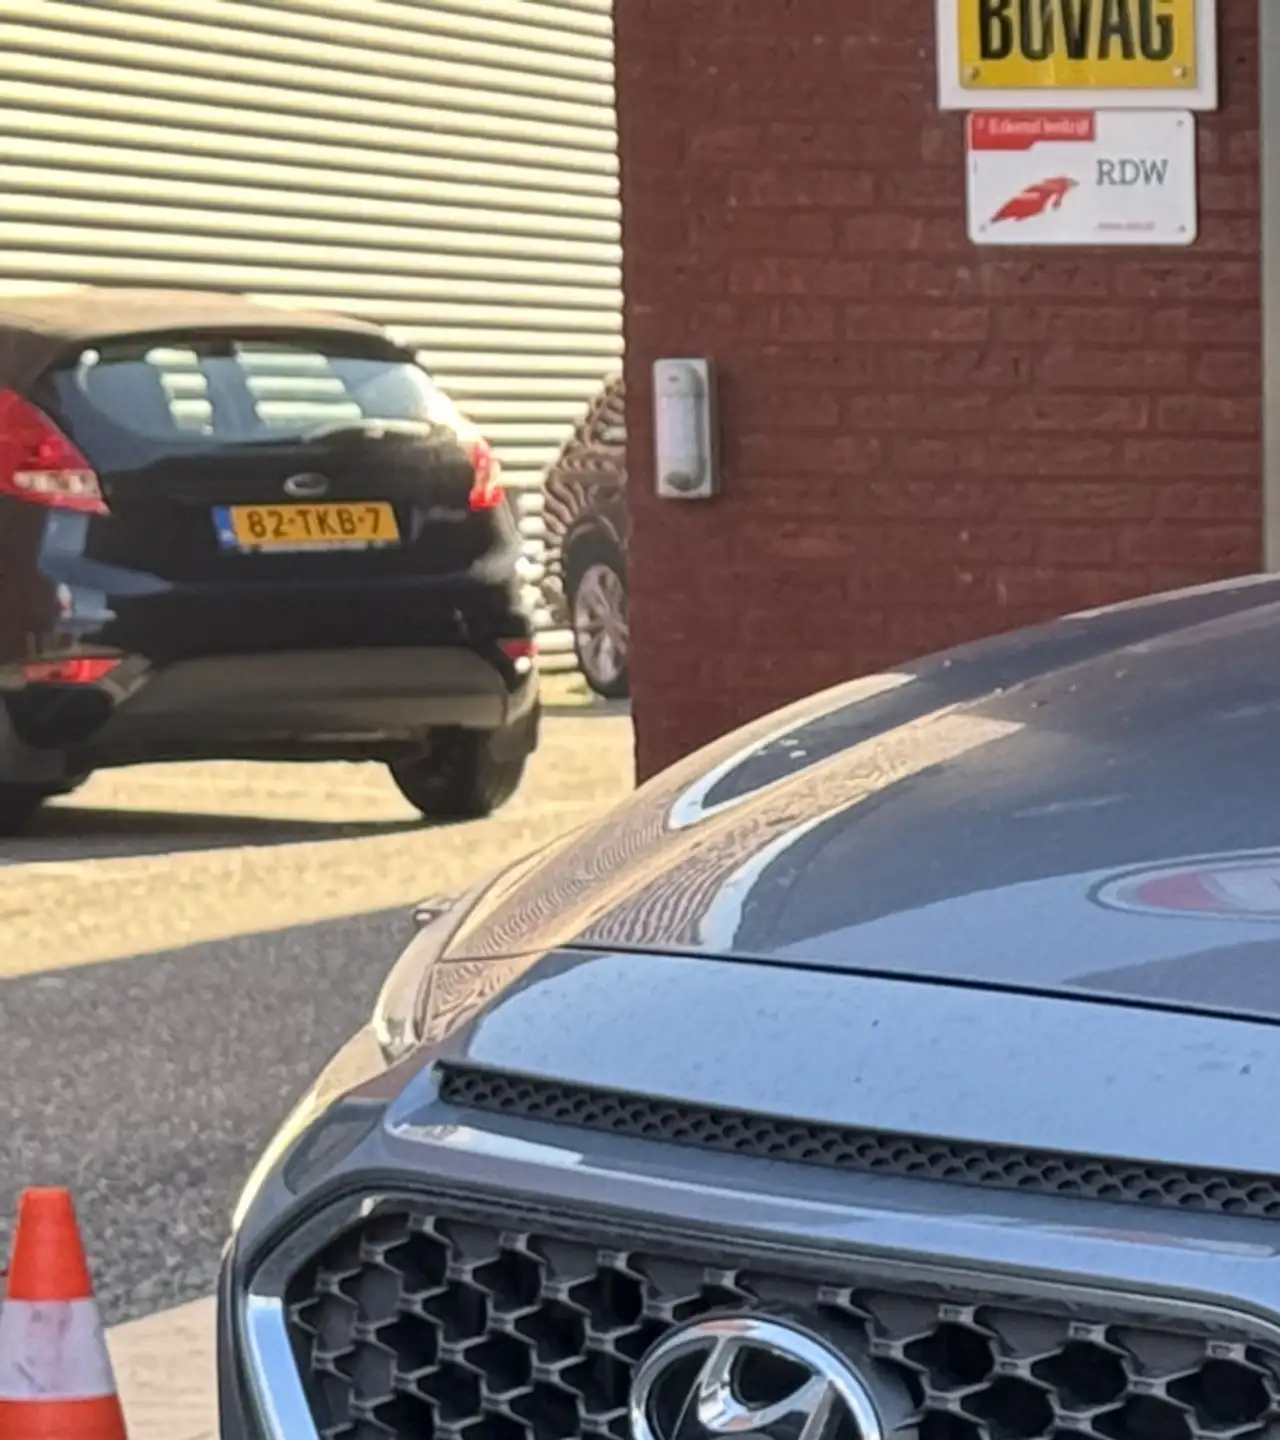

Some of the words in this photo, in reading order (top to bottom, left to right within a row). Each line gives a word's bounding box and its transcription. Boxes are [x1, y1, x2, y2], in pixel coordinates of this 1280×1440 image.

[978, 0, 1176, 61] BOVAG
[1095, 158, 1169, 186] RDW
[246, 505, 382, 539] 82-TKB-7
